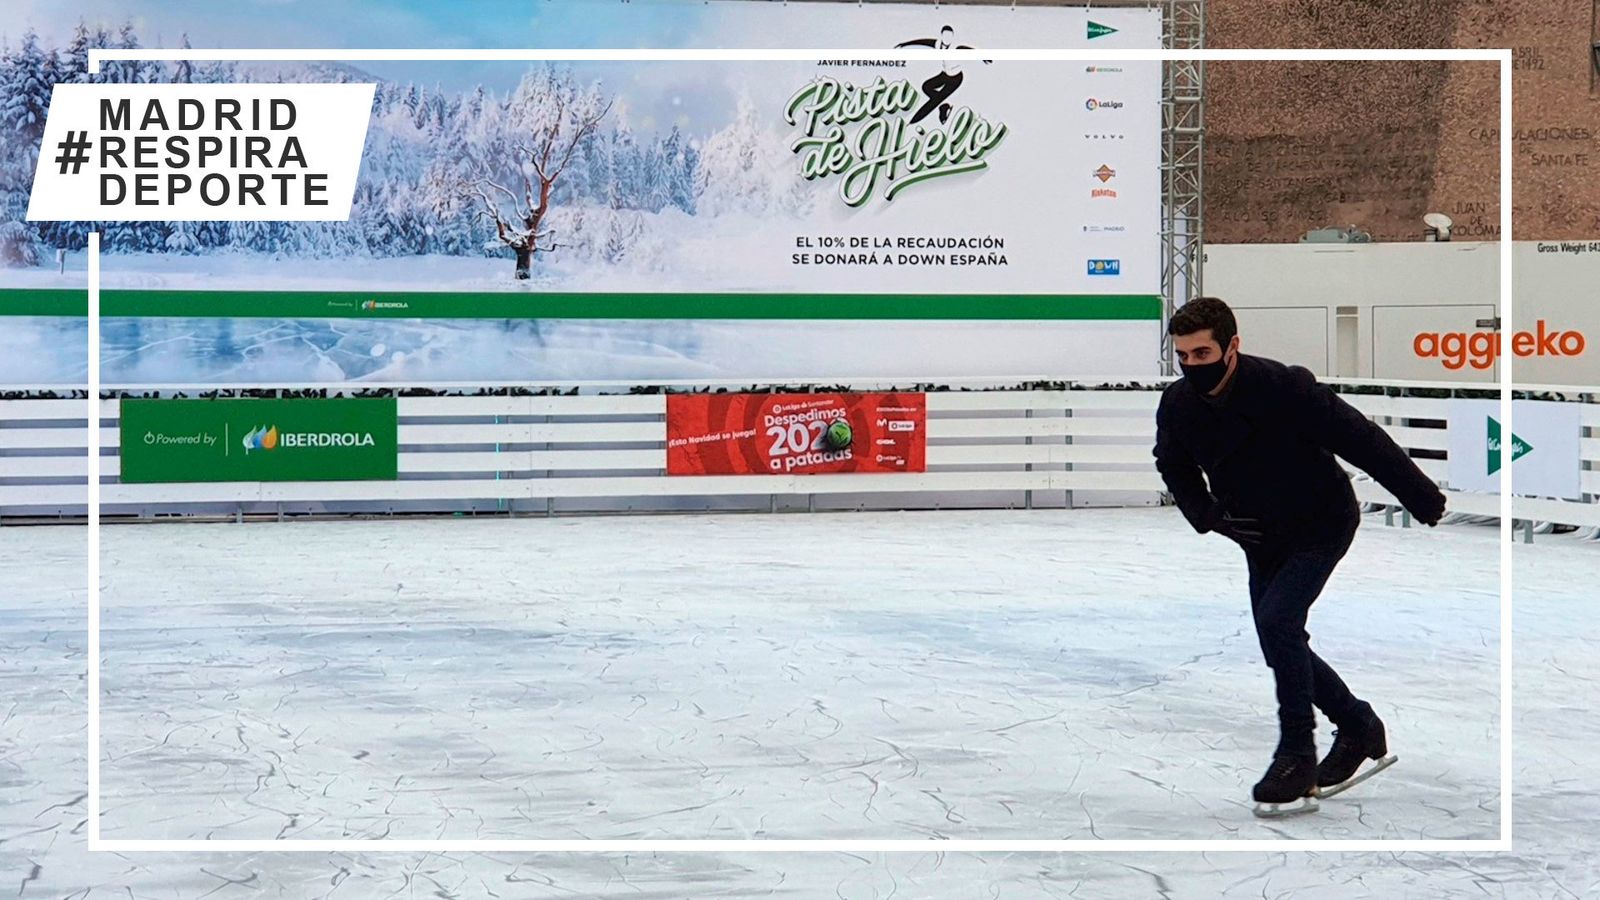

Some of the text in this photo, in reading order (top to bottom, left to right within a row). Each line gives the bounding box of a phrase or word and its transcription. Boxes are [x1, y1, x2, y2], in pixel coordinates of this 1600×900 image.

[782, 74, 917, 136] Pista
[1098, 100, 1124, 109] LaLiga
[789, 105, 1009, 208] de Hielo
[1532, 154, 1588, 167] SANTA FE
[1452, 201, 1486, 214] JUAN
[1470, 215, 1484, 226] DE
[795, 235, 1004, 250] EL 10% DE LA RECAUDACIÓN
[1537, 242, 1558, 253] Gross
[1560, 242, 1586, 255] Weight
[791, 251, 1009, 267] SE DONARÁ A DOWN ESPAÑA
[763, 407, 847, 428] Despedimos
[155, 432, 217, 447] Powered by
[280, 432, 375, 447] IBERDROLA
[688, 433, 721, 444] Navidad
[721, 432, 731, 440] se
[769, 458, 782, 470] a
